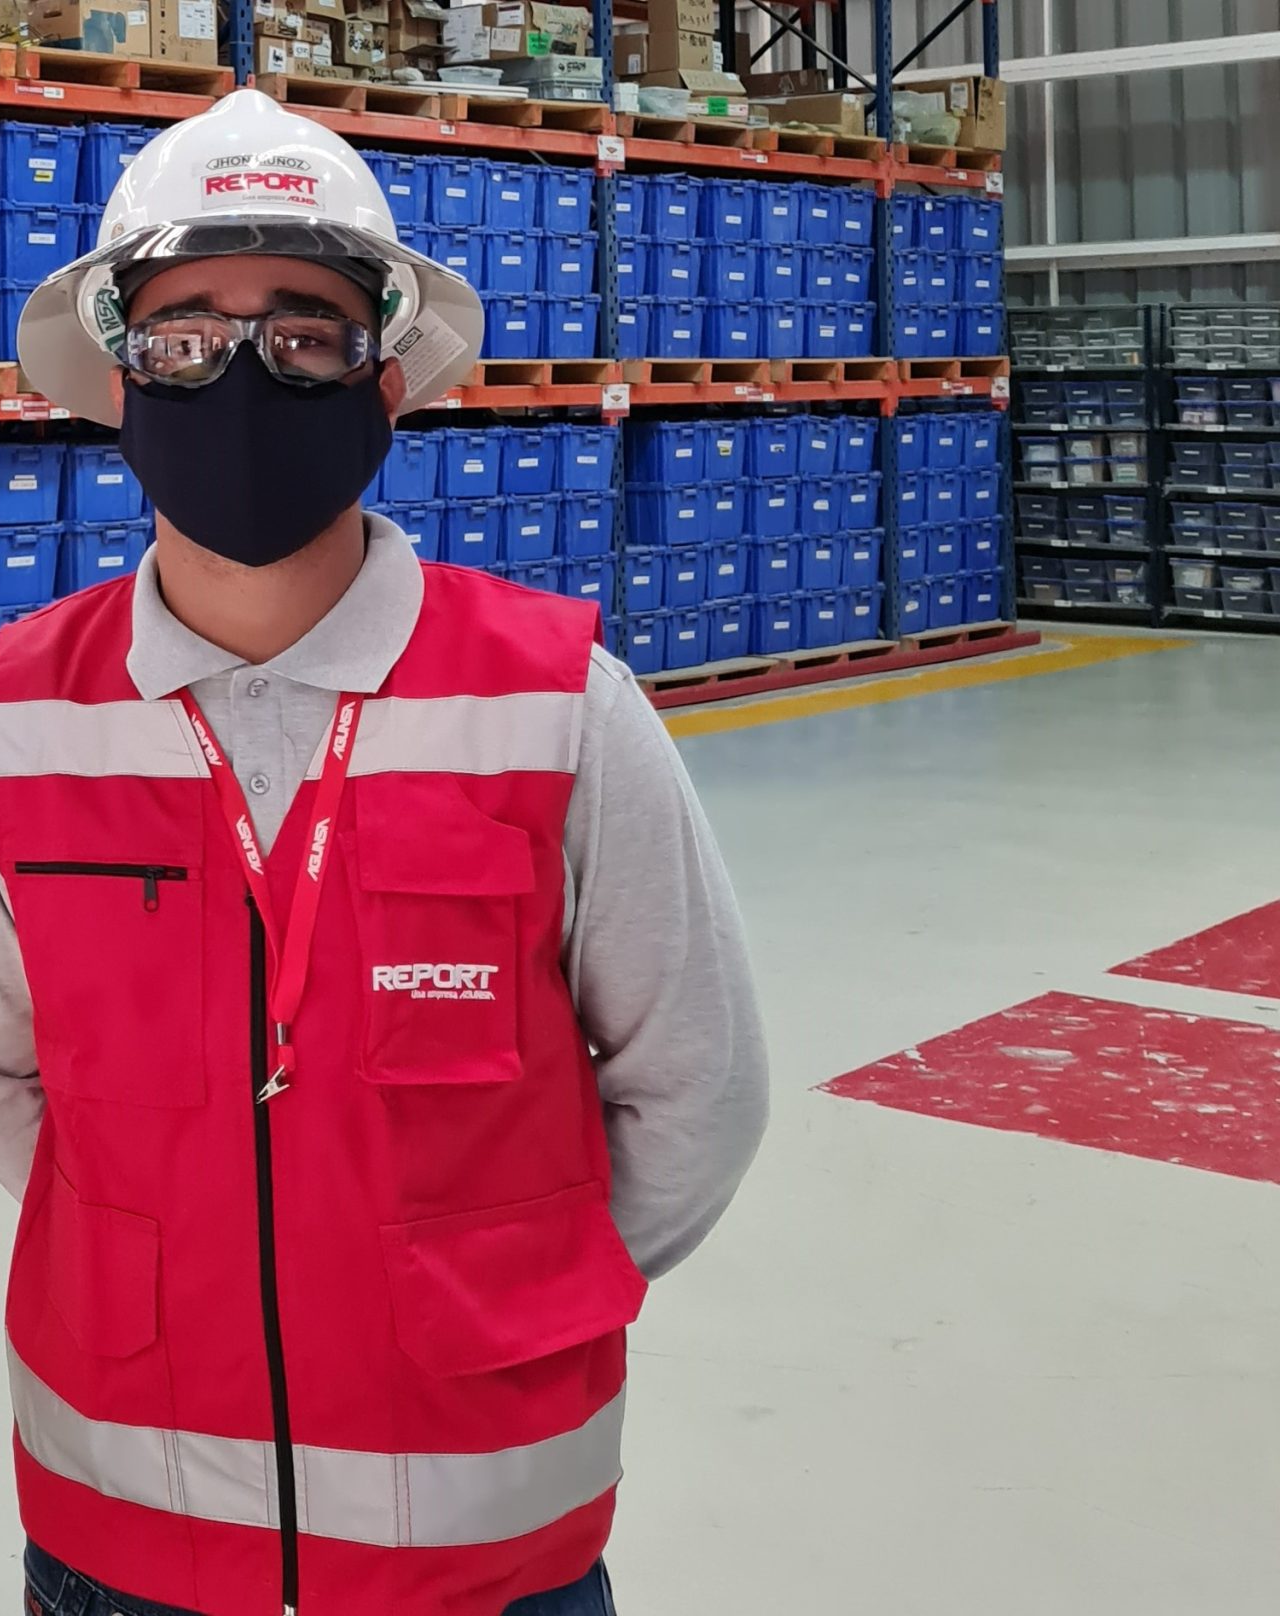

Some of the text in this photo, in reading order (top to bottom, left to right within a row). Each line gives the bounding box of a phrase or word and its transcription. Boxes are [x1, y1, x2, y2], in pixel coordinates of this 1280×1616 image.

[205, 172, 319, 195] REPORT
[332, 701, 356, 761] AGUNSA
[235, 814, 265, 876] AGUNSA
[307, 817, 331, 882] AGUNSA
[372, 963, 499, 992] REPORT
